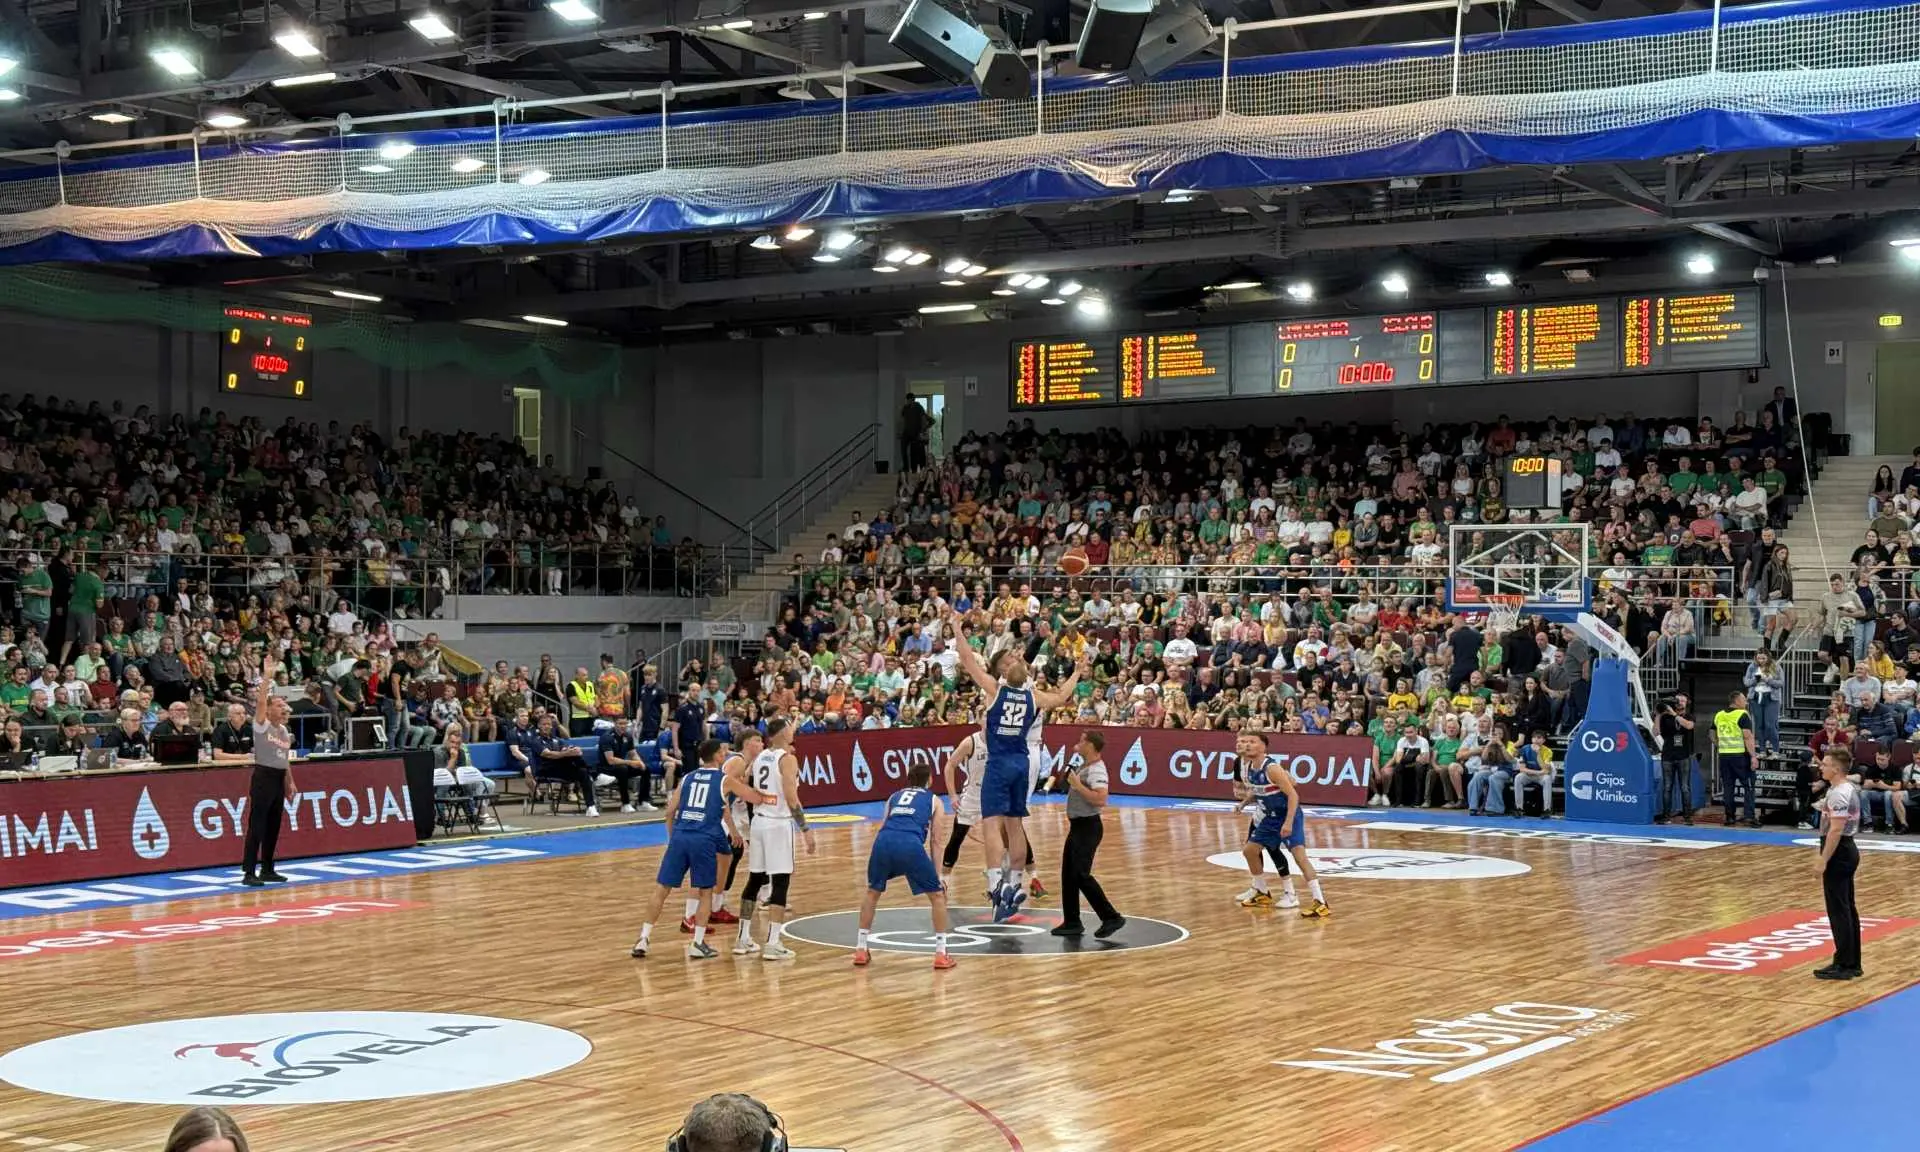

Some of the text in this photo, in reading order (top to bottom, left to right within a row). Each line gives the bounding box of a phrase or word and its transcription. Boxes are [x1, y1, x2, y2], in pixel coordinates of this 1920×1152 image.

[1656, 298, 1664, 307] 0
[1521, 309, 1528, 318] 0
[1656, 308, 1664, 317] 0
[1521, 318, 1528, 327] 0
[1656, 318, 1664, 326] 0
[231, 328, 240, 344] 0
[1521, 328, 1528, 336] 0
[1656, 327, 1664, 336] 0
[1148, 336, 1154, 344] 0
[1420, 334, 1433, 354] 0
[1521, 336, 1528, 345] 0
[1656, 336, 1664, 345] 0
[1283, 343, 1360, 363] 0 1
[1521, 345, 1528, 354] 0
[1828, 348, 1840, 357] D1
[1148, 353, 1154, 361] 0
[1521, 355, 1528, 364] 0
[1148, 362, 1154, 370] 0
[1420, 360, 1433, 379] 0
[1521, 364, 1528, 373] 0
[227, 373, 237, 389] 0
[1148, 370, 1154, 379] 0
[1279, 368, 1292, 388] 0
[296, 380, 304, 395] 0
[1512, 457, 1545, 473] 10:00
[1000, 701, 1027, 726] 32
[1581, 731, 1628, 752] Go3
[1169, 749, 1371, 788] GYDTOJAI
[759, 765, 770, 790] 2
[1596, 772, 1625, 787] Gijos
[687, 782, 710, 809] 10
[897, 790, 917, 805] 6
[1595, 790, 1638, 803] Klinikos
[193, 784, 414, 840] GYYTOJAI
[1270, 1001, 1609, 1079] Nostra
[186, 1024, 503, 1099] BIOVELA
